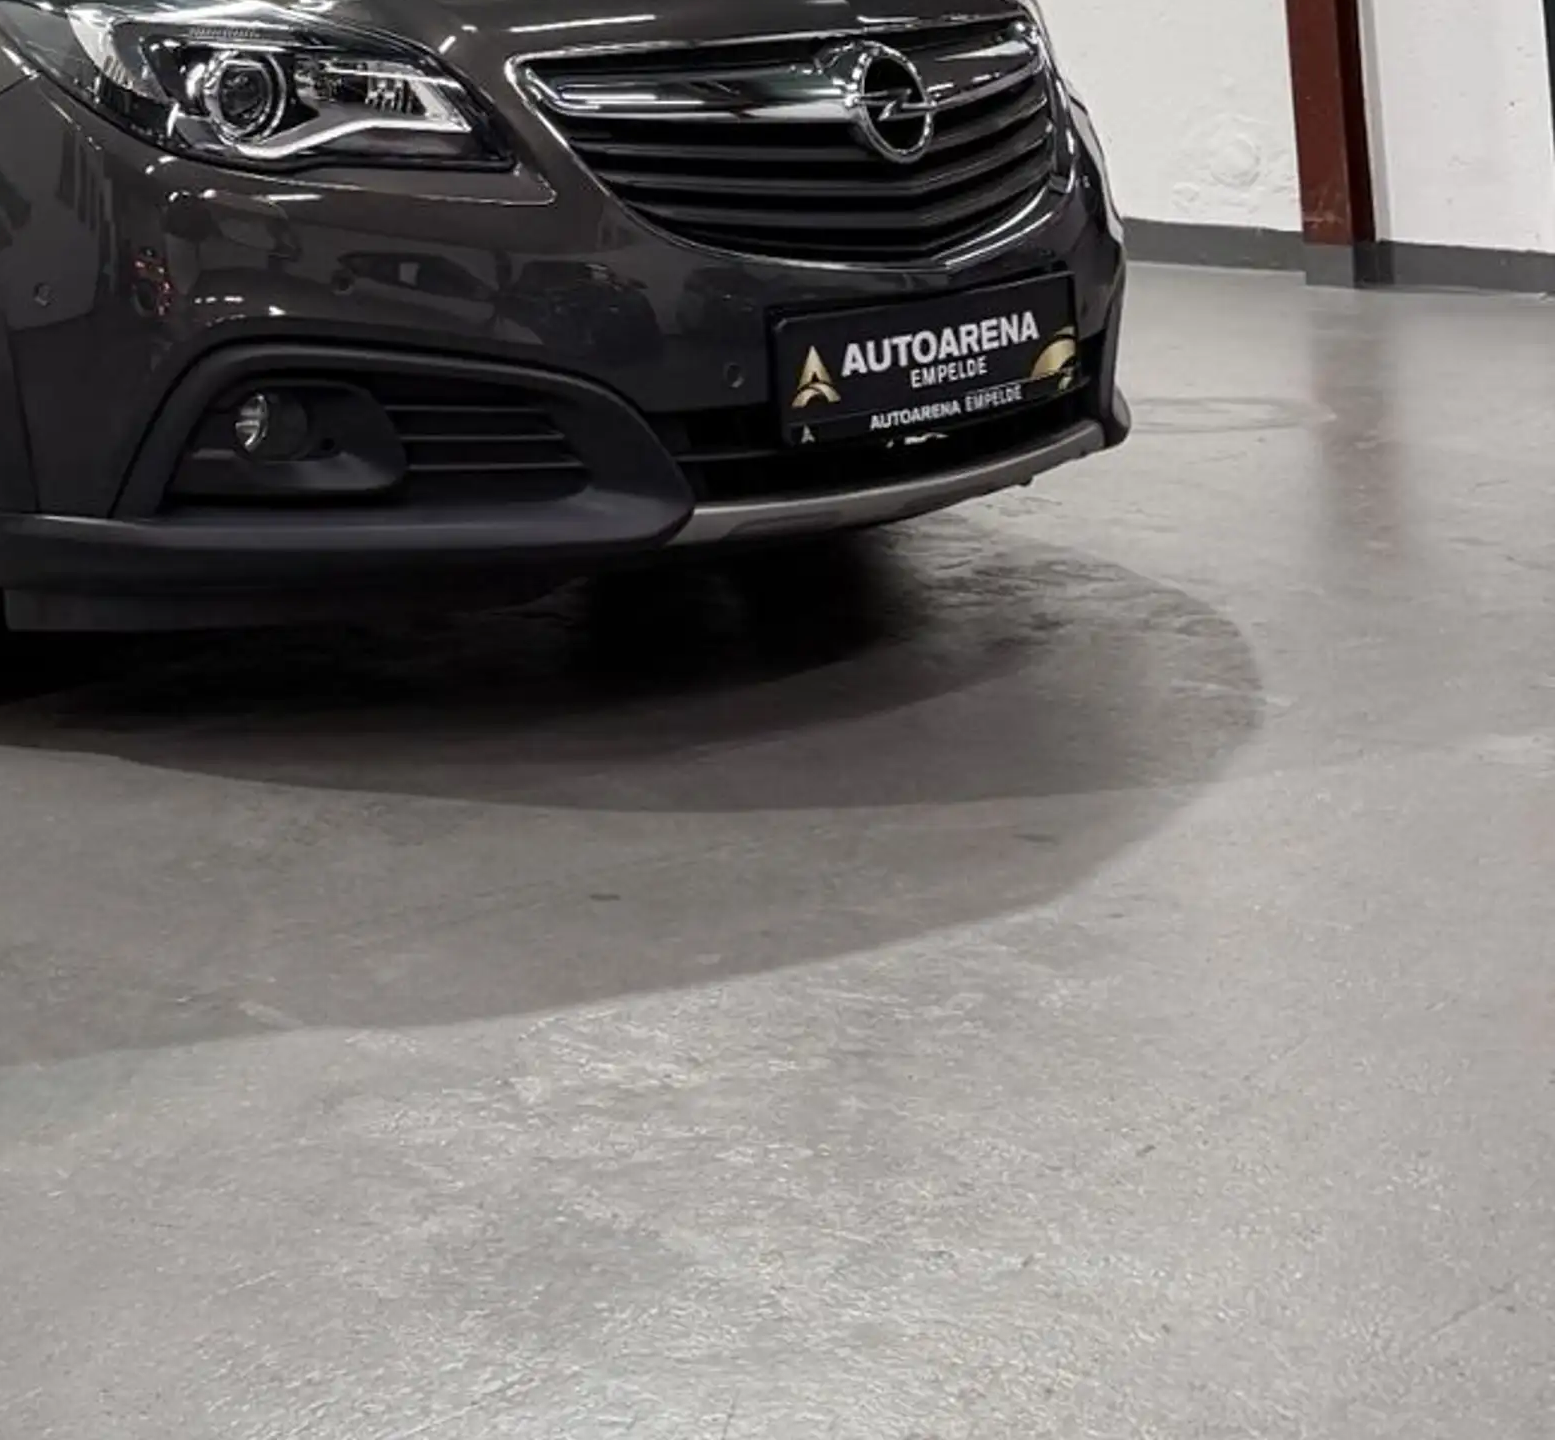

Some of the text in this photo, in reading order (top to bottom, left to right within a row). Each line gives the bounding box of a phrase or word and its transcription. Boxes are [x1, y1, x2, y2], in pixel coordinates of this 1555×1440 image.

[841, 310, 1040, 377] AUTOARENA
[910, 357, 988, 389] EMPELDE
[870, 384, 1022, 430] AUTOARENA EMPELDE
